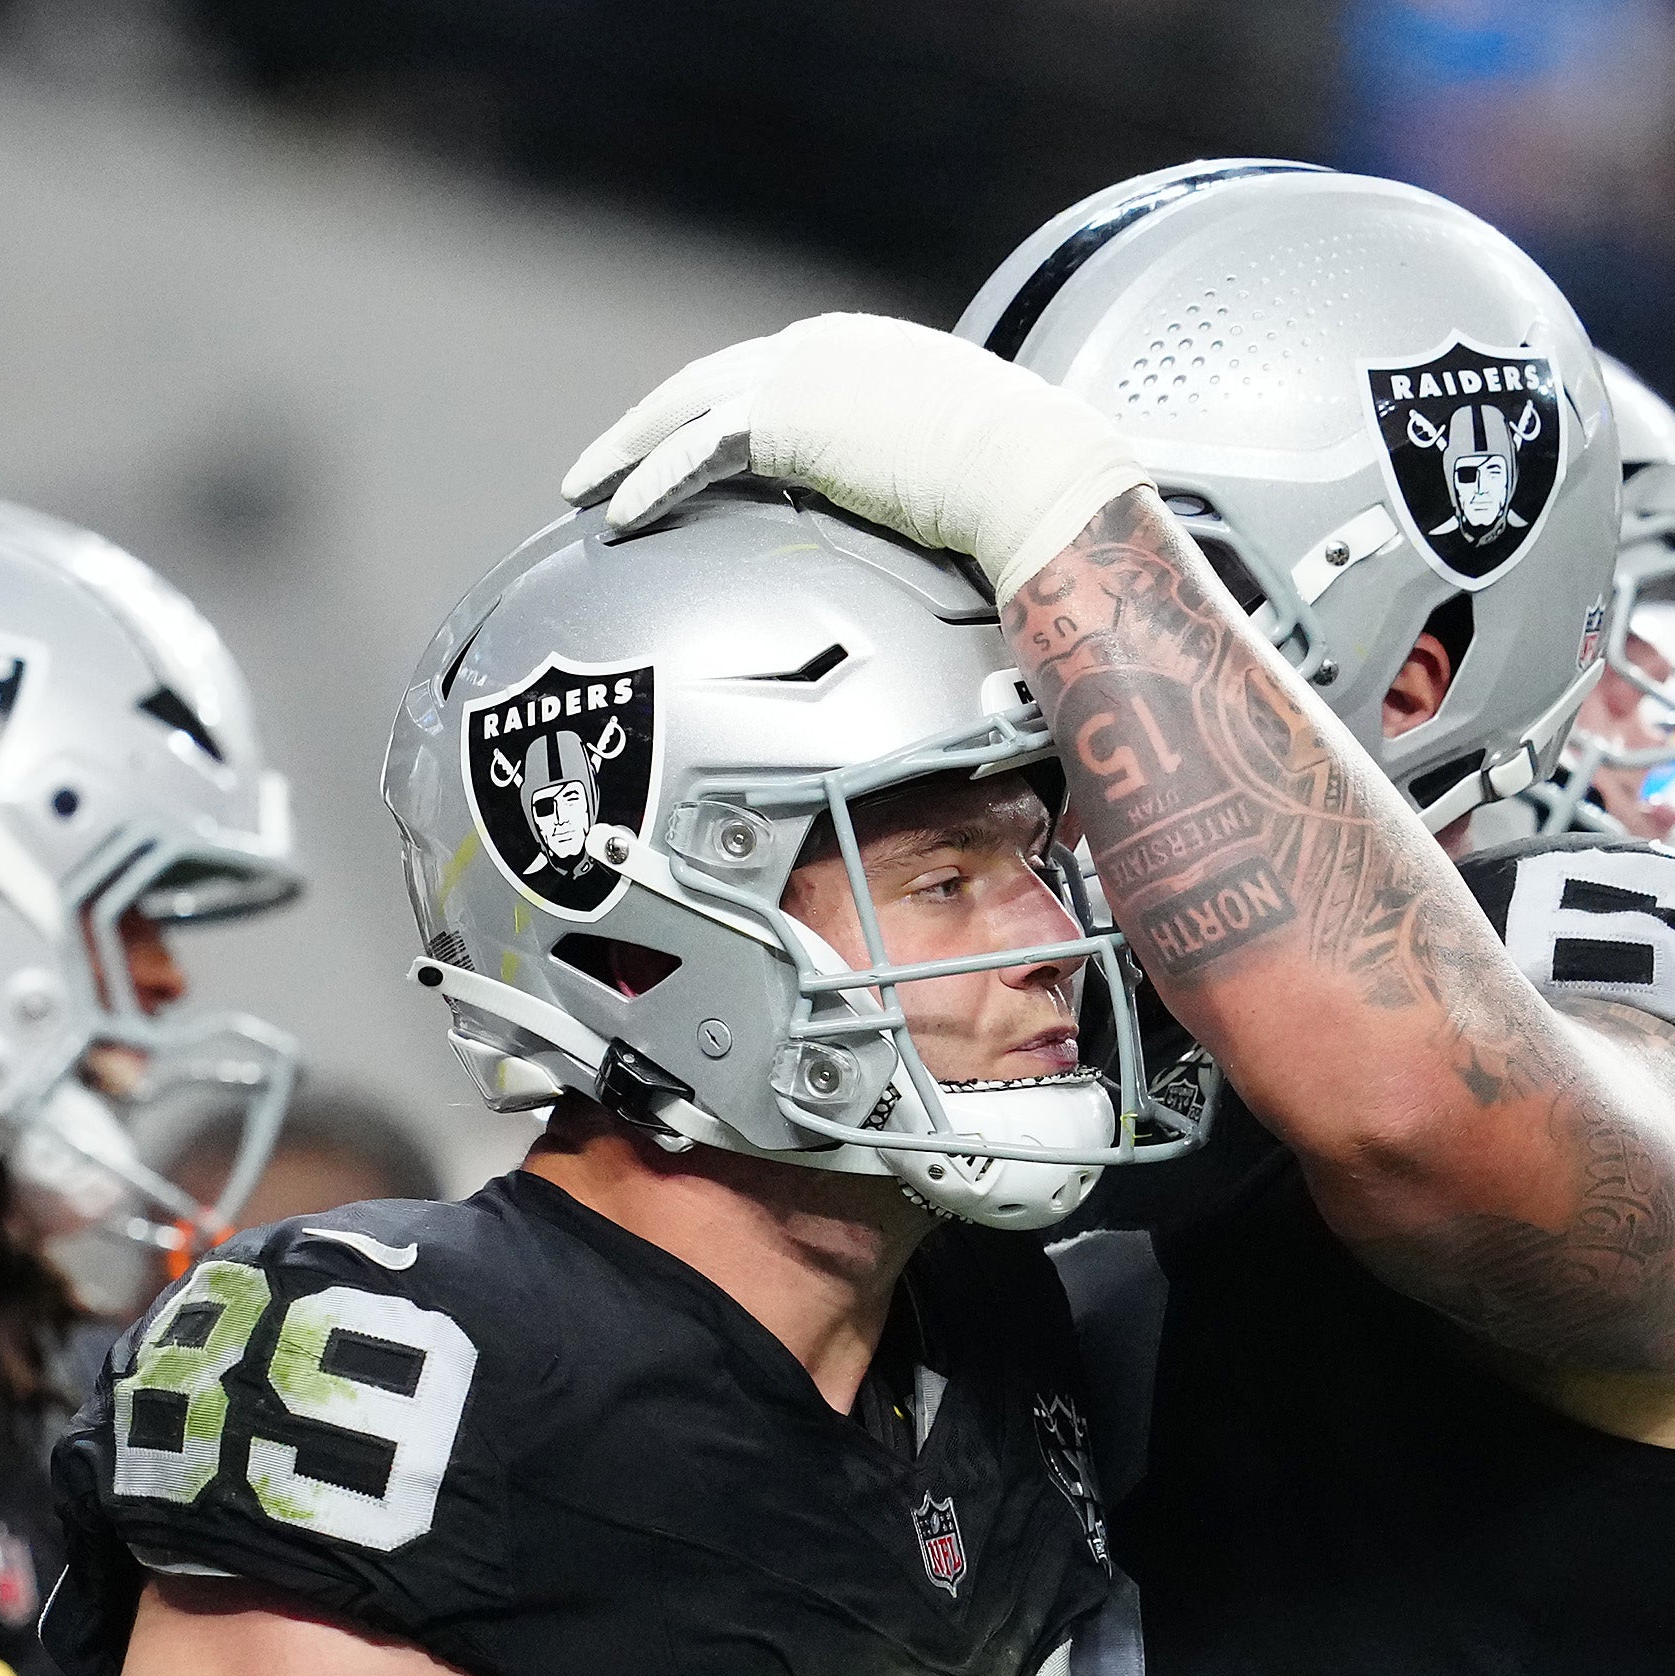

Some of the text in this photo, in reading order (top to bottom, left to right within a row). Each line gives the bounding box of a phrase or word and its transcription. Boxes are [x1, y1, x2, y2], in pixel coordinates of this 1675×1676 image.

[1390, 364, 1539, 400] RAIDERS
[484, 678, 633, 740] RAIDERS
[1076, 695, 1183, 801] 15
[1150, 870, 1285, 962] NORTH
[113, 1260, 478, 1552] 89
[927, 1536, 963, 1577] NFL
